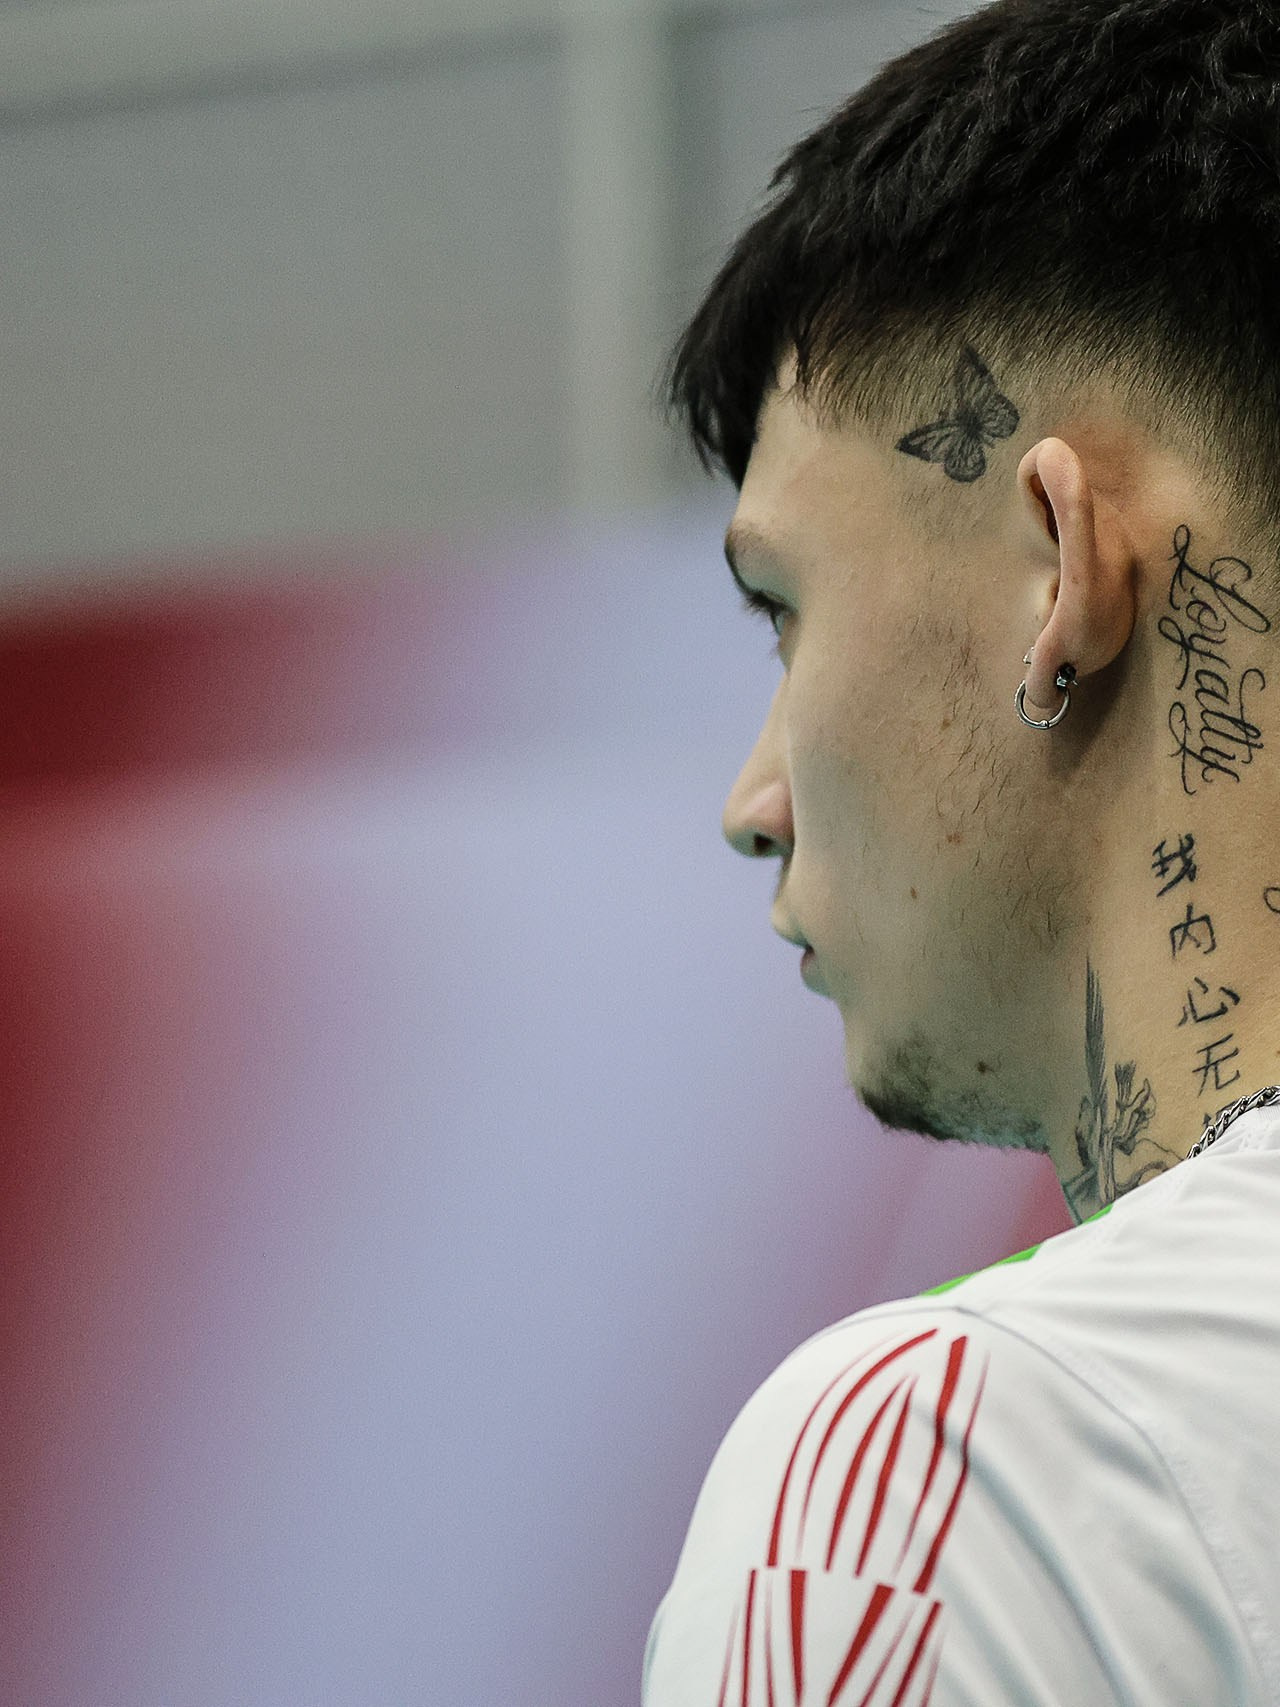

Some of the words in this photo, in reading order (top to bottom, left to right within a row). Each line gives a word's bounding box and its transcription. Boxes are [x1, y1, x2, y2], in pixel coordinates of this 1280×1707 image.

[1158, 524, 1271, 795] Loyalty
[1151, 833, 1241, 1128] 我内心无
